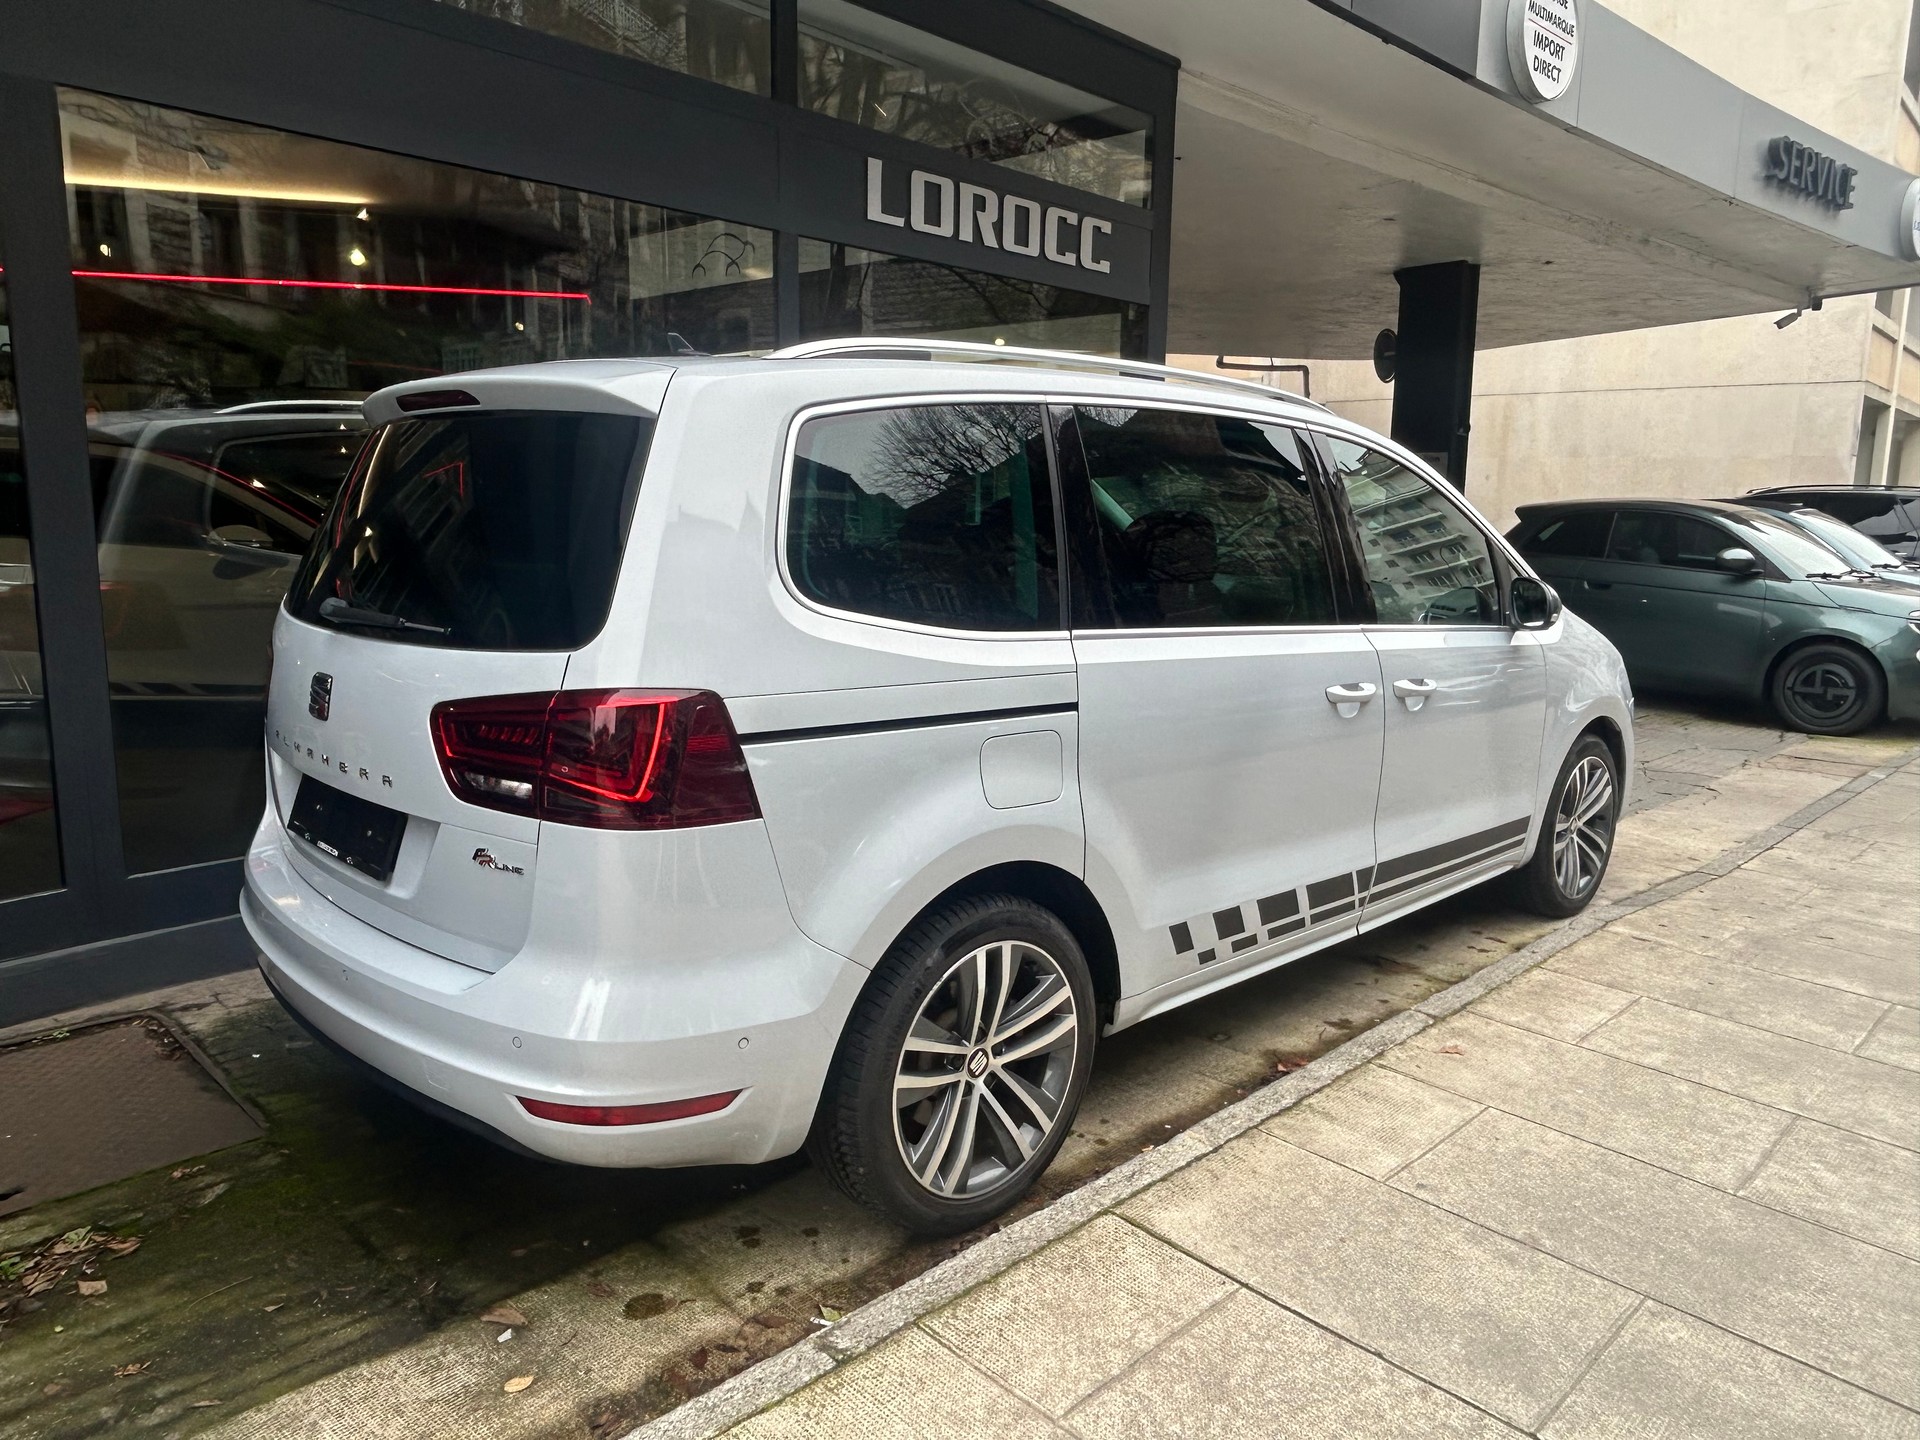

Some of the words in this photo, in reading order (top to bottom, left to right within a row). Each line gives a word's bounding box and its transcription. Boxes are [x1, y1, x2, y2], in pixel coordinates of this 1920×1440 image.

[1528, 0, 1575, 37] MULTIMARQUE
[1533, 30, 1565, 61] IMPORT
[1533, 54, 1562, 84] DIRECT
[1765, 135, 1858, 209] SERVICE
[867, 156, 1112, 273] LOROCC
